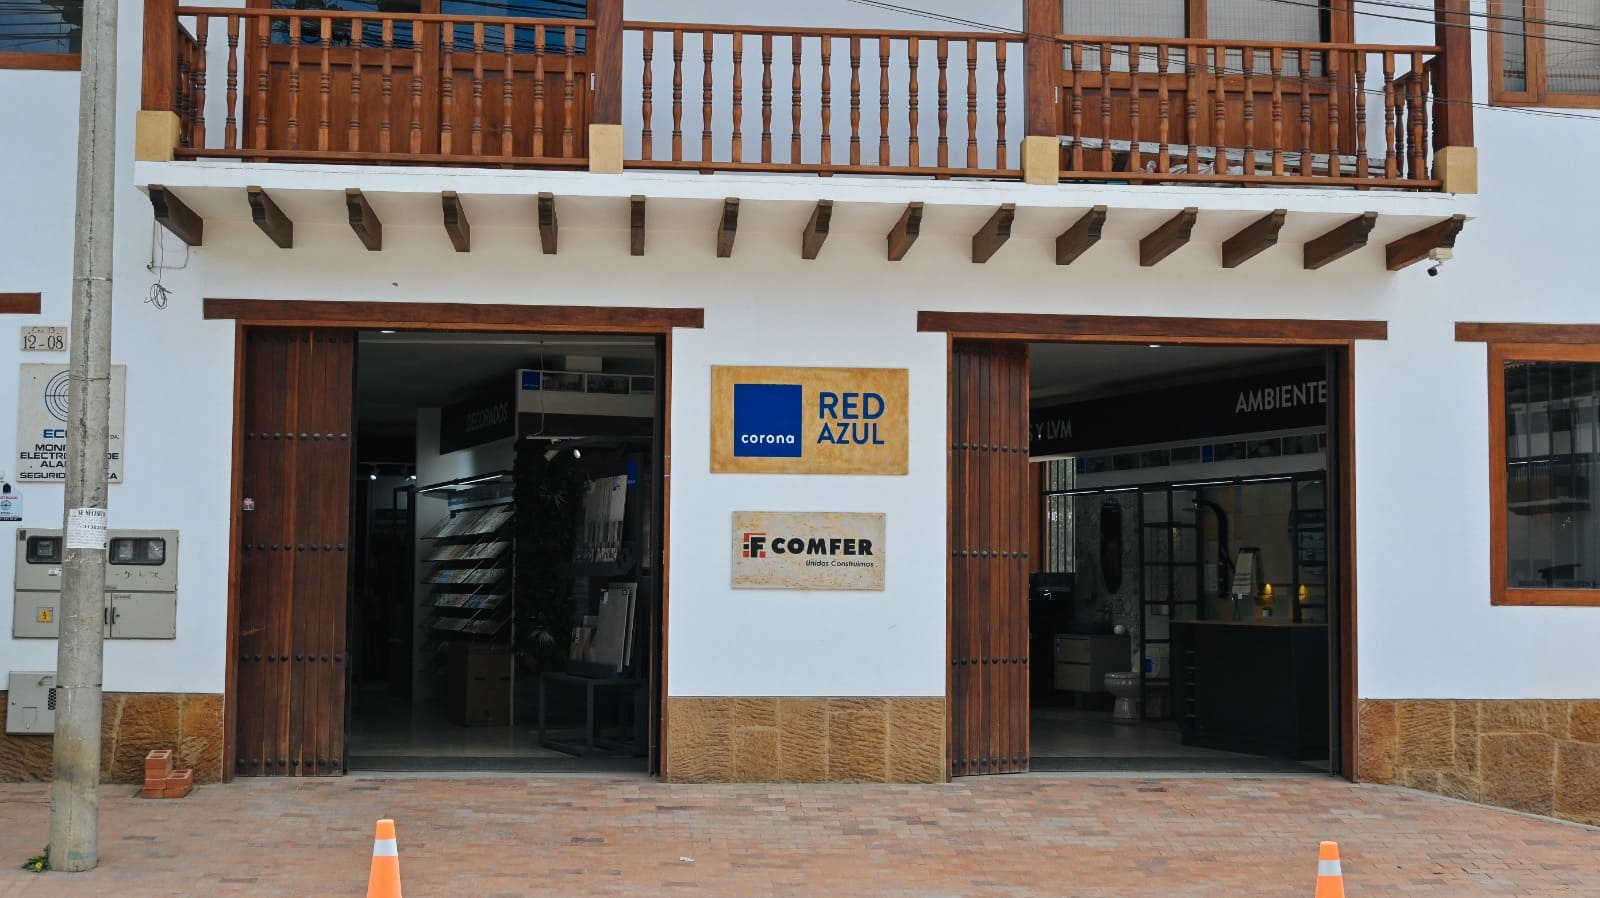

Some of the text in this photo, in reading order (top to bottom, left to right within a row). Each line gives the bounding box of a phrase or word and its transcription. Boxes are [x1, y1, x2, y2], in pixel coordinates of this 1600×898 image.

[819, 391, 886, 420] RED
[43, 429, 67, 438] EC
[741, 433, 795, 444] corona
[816, 422, 885, 445] AZUL
[35, 444, 66, 452] MONI
[20, 452, 66, 460] ELECTR
[40, 460, 66, 468] ALA
[771, 537, 873, 556] COMFER
